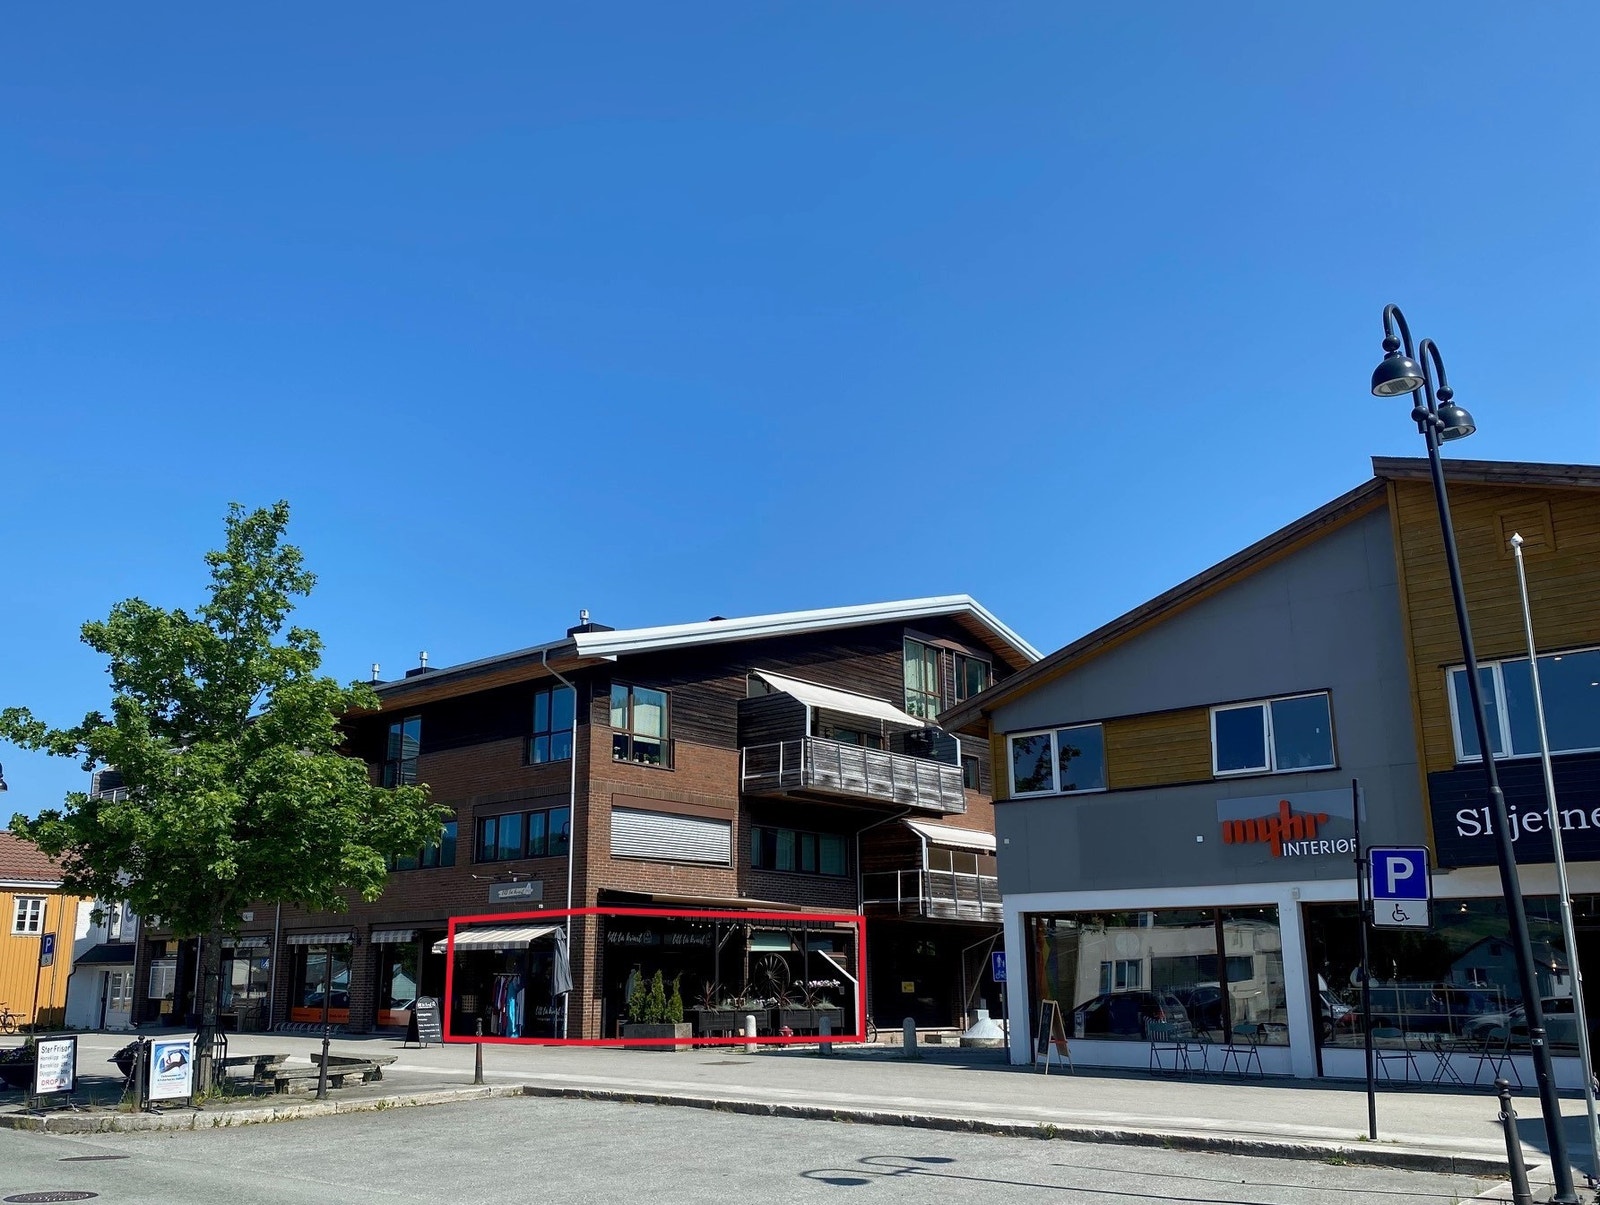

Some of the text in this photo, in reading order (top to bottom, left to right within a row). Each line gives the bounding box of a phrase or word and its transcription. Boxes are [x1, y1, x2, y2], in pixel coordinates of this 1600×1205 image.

[1222, 799, 1330, 858] myhr
[1386, 857, 1414, 893] P
[46, 937, 52, 952] P
